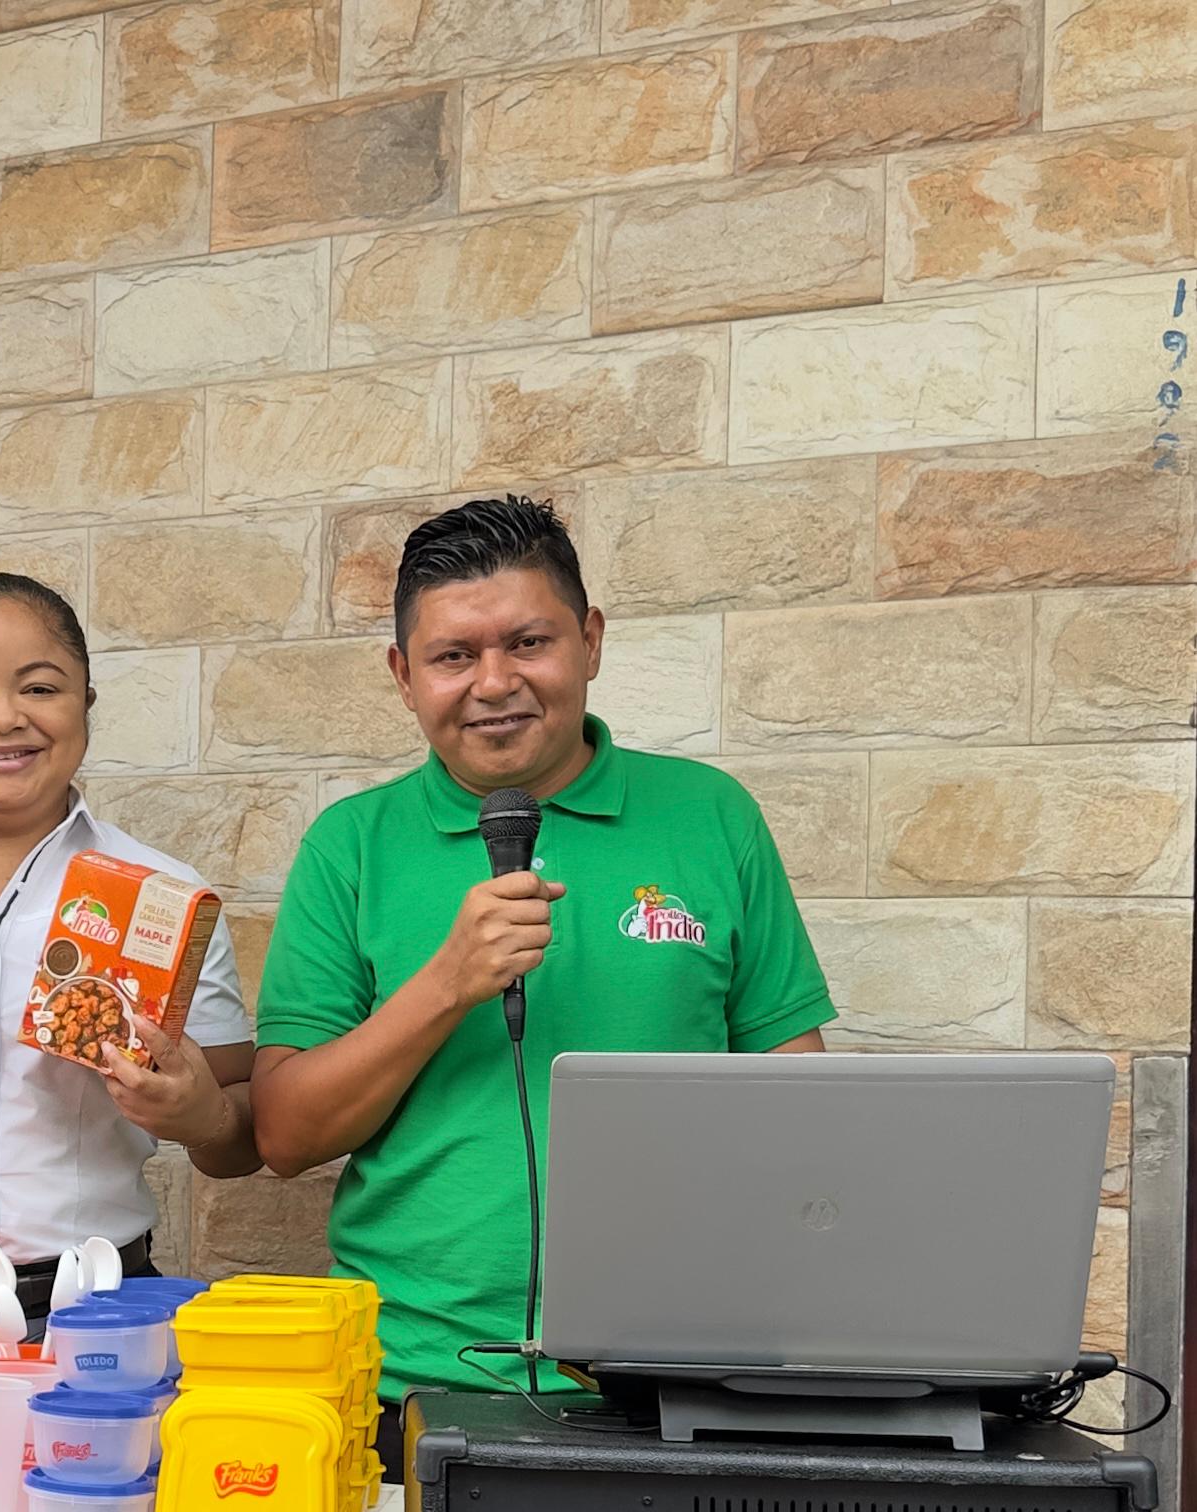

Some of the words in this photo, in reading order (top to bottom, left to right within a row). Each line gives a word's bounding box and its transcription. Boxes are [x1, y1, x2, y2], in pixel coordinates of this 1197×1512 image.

[655, 910, 683, 920] Pollo
[73, 911, 119, 944] Indio
[133, 926, 174, 946] MAPLE
[648, 915, 705, 944] Indio
[76, 1355, 116, 1368] TOLEDO
[220, 1460, 273, 1488] Franks
